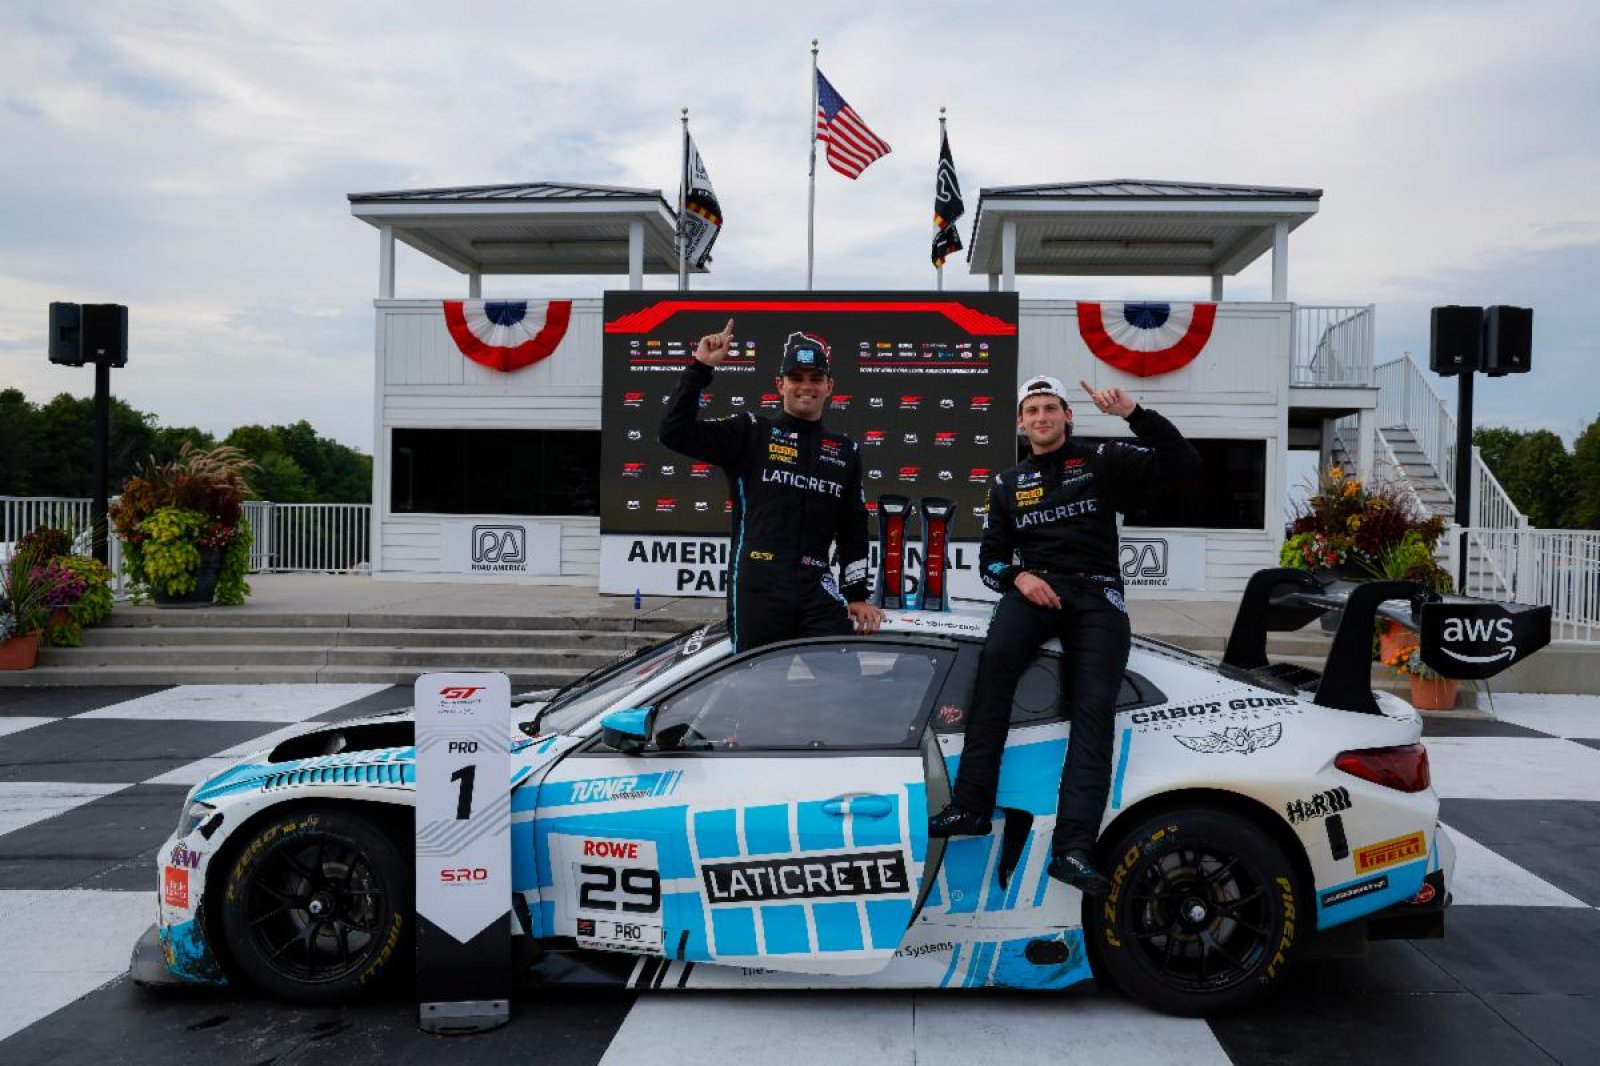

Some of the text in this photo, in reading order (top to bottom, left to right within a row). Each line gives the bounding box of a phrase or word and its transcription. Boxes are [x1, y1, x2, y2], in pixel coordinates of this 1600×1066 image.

[762, 468, 843, 498] LATICRETE
[1015, 498, 1098, 529] LATICRETE
[627, 540, 727, 564] AMERI
[492, 563, 526, 572] AMERICA
[676, 568, 728, 592] PA
[1443, 617, 1513, 642] aws
[1131, 701, 1222, 724] CABOT
[1228, 697, 1299, 711] GUNS
[448, 741, 478, 754] PRO
[450, 764, 476, 820] 1
[570, 776, 639, 803] TURNER
[583, 840, 638, 859] ROWE
[1359, 836, 1420, 869] PIRELLI
[440, 868, 488, 882] SRO
[708, 858, 902, 899] LATICRETE
[579, 864, 661, 913] 29
[615, 924, 641, 939] PRO
[904, 940, 954, 959] Systems
